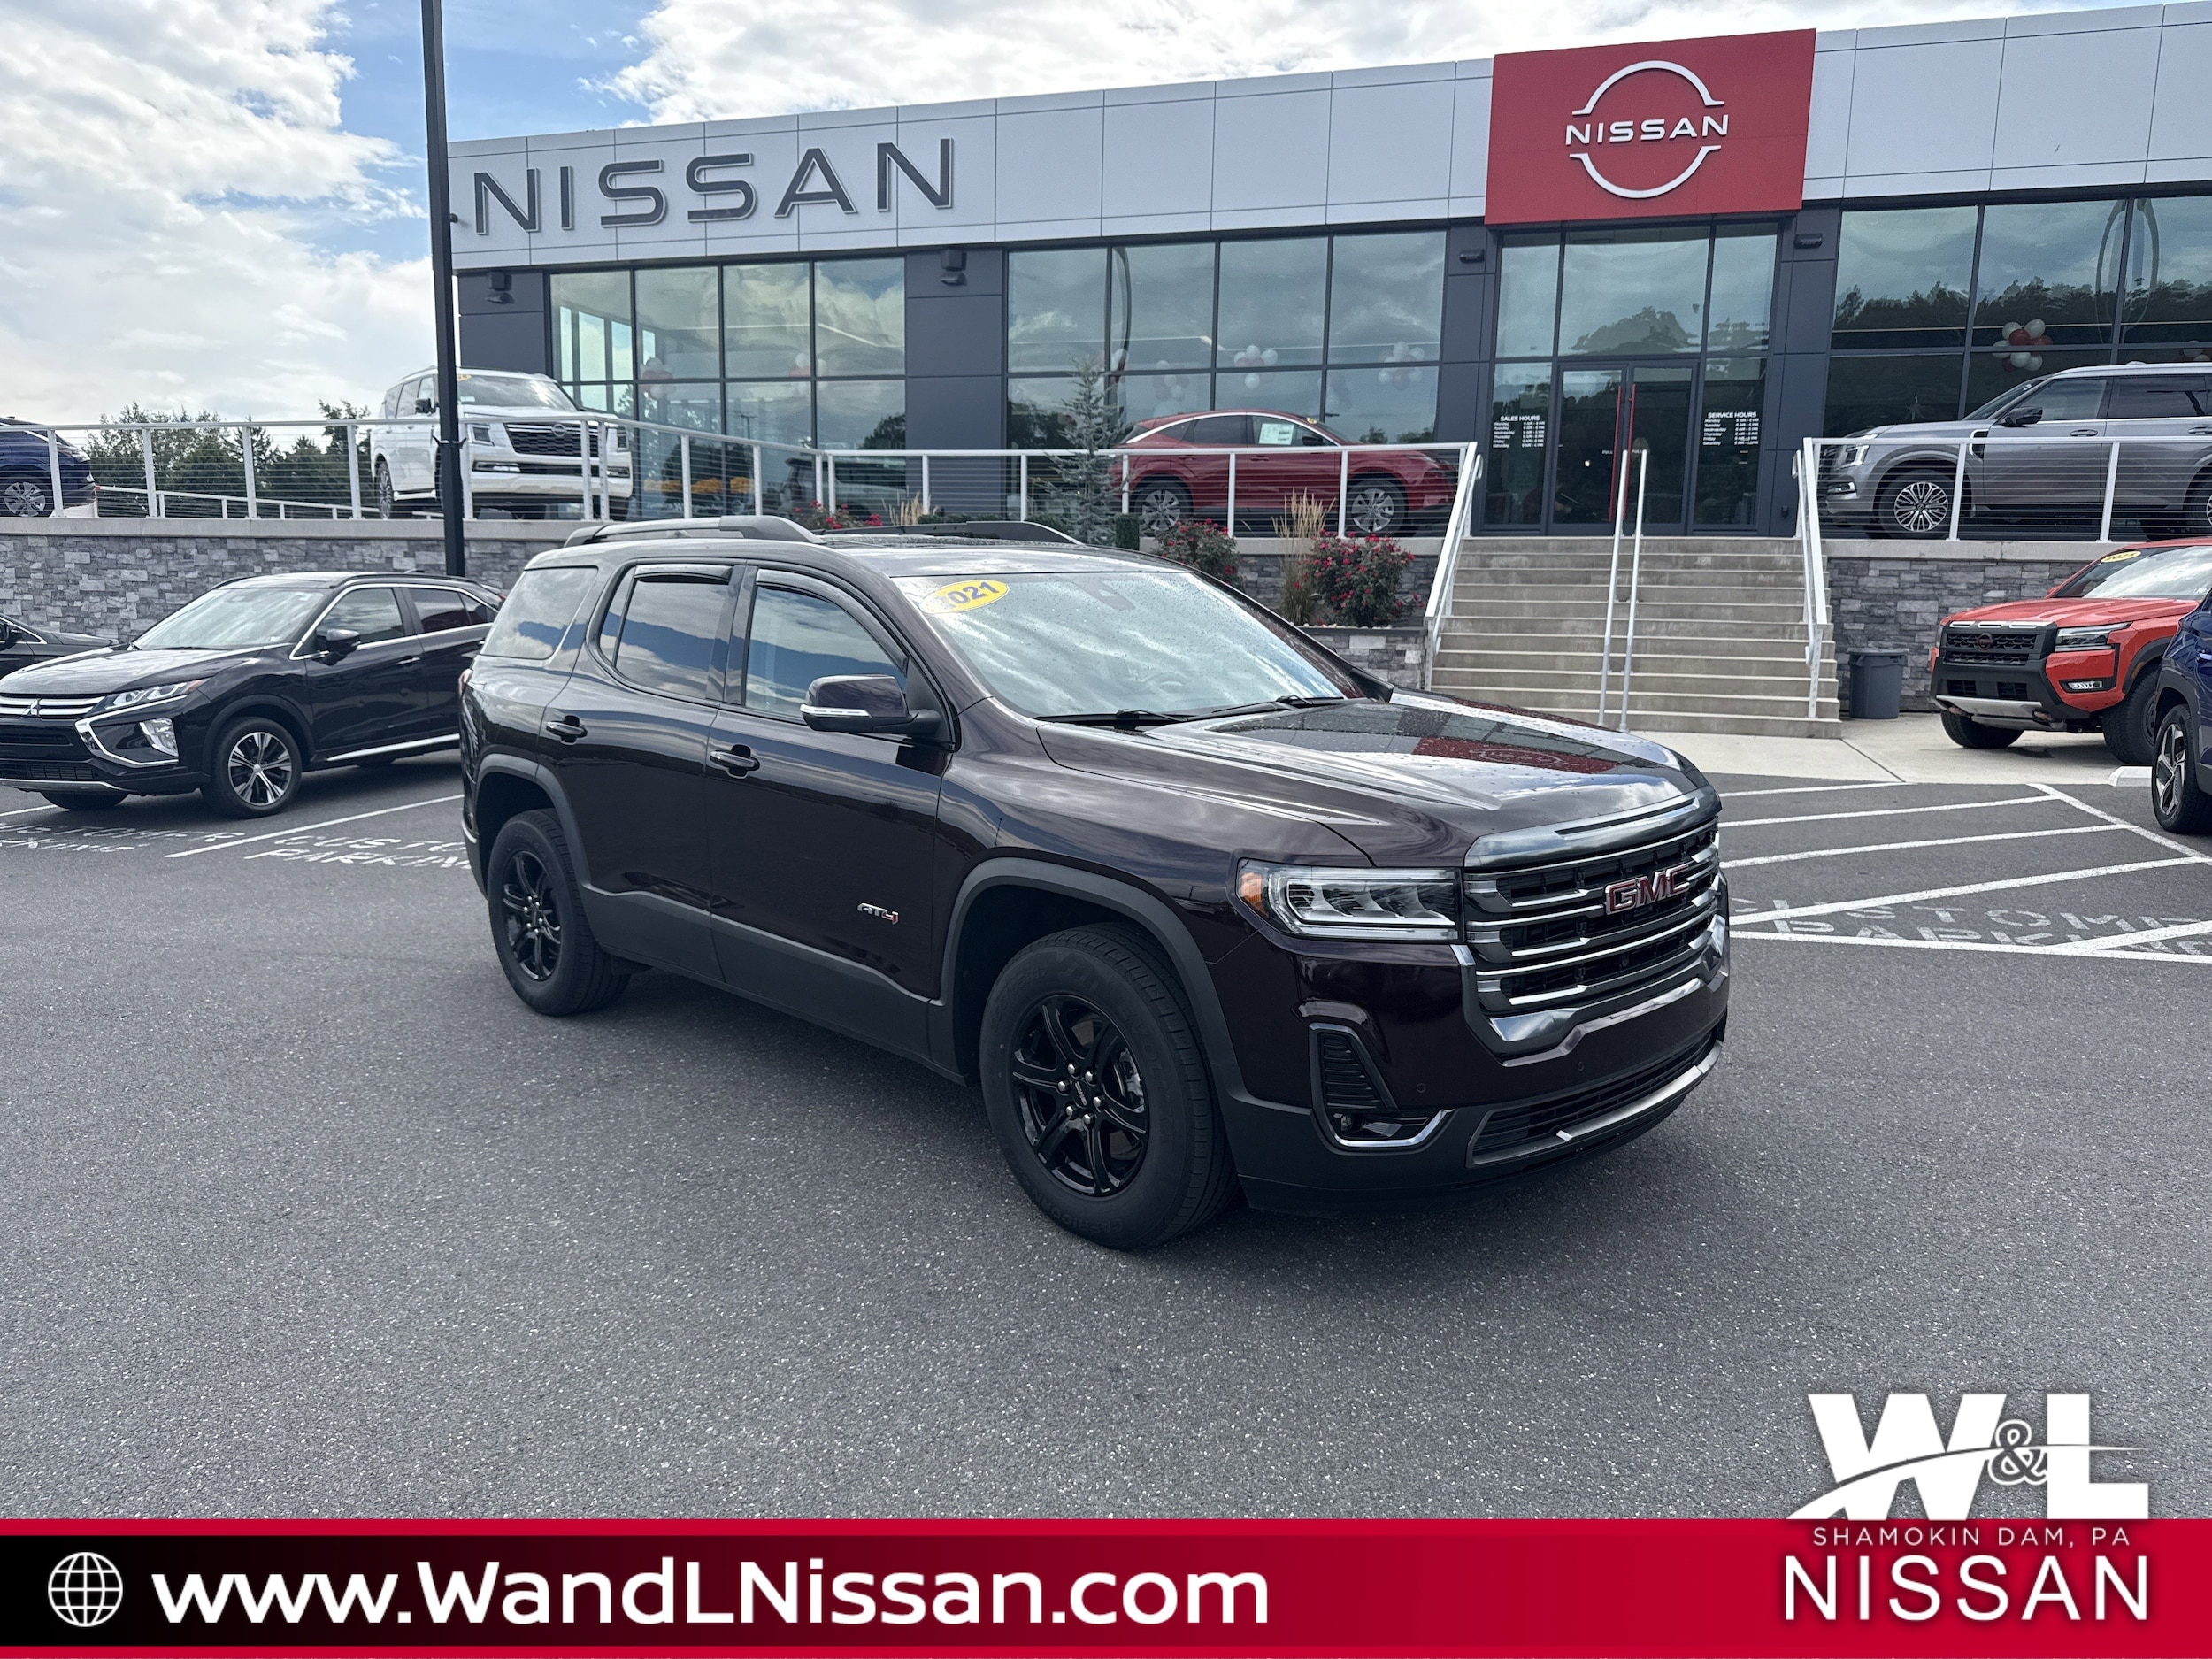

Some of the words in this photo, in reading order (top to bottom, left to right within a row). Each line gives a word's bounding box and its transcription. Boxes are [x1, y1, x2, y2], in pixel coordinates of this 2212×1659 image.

[1564, 113, 1730, 146] NISSAN
[473, 137, 954, 235] NISSAN
[243, 849, 472, 870] PARKIN
[1605, 864, 1690, 916] GMC
